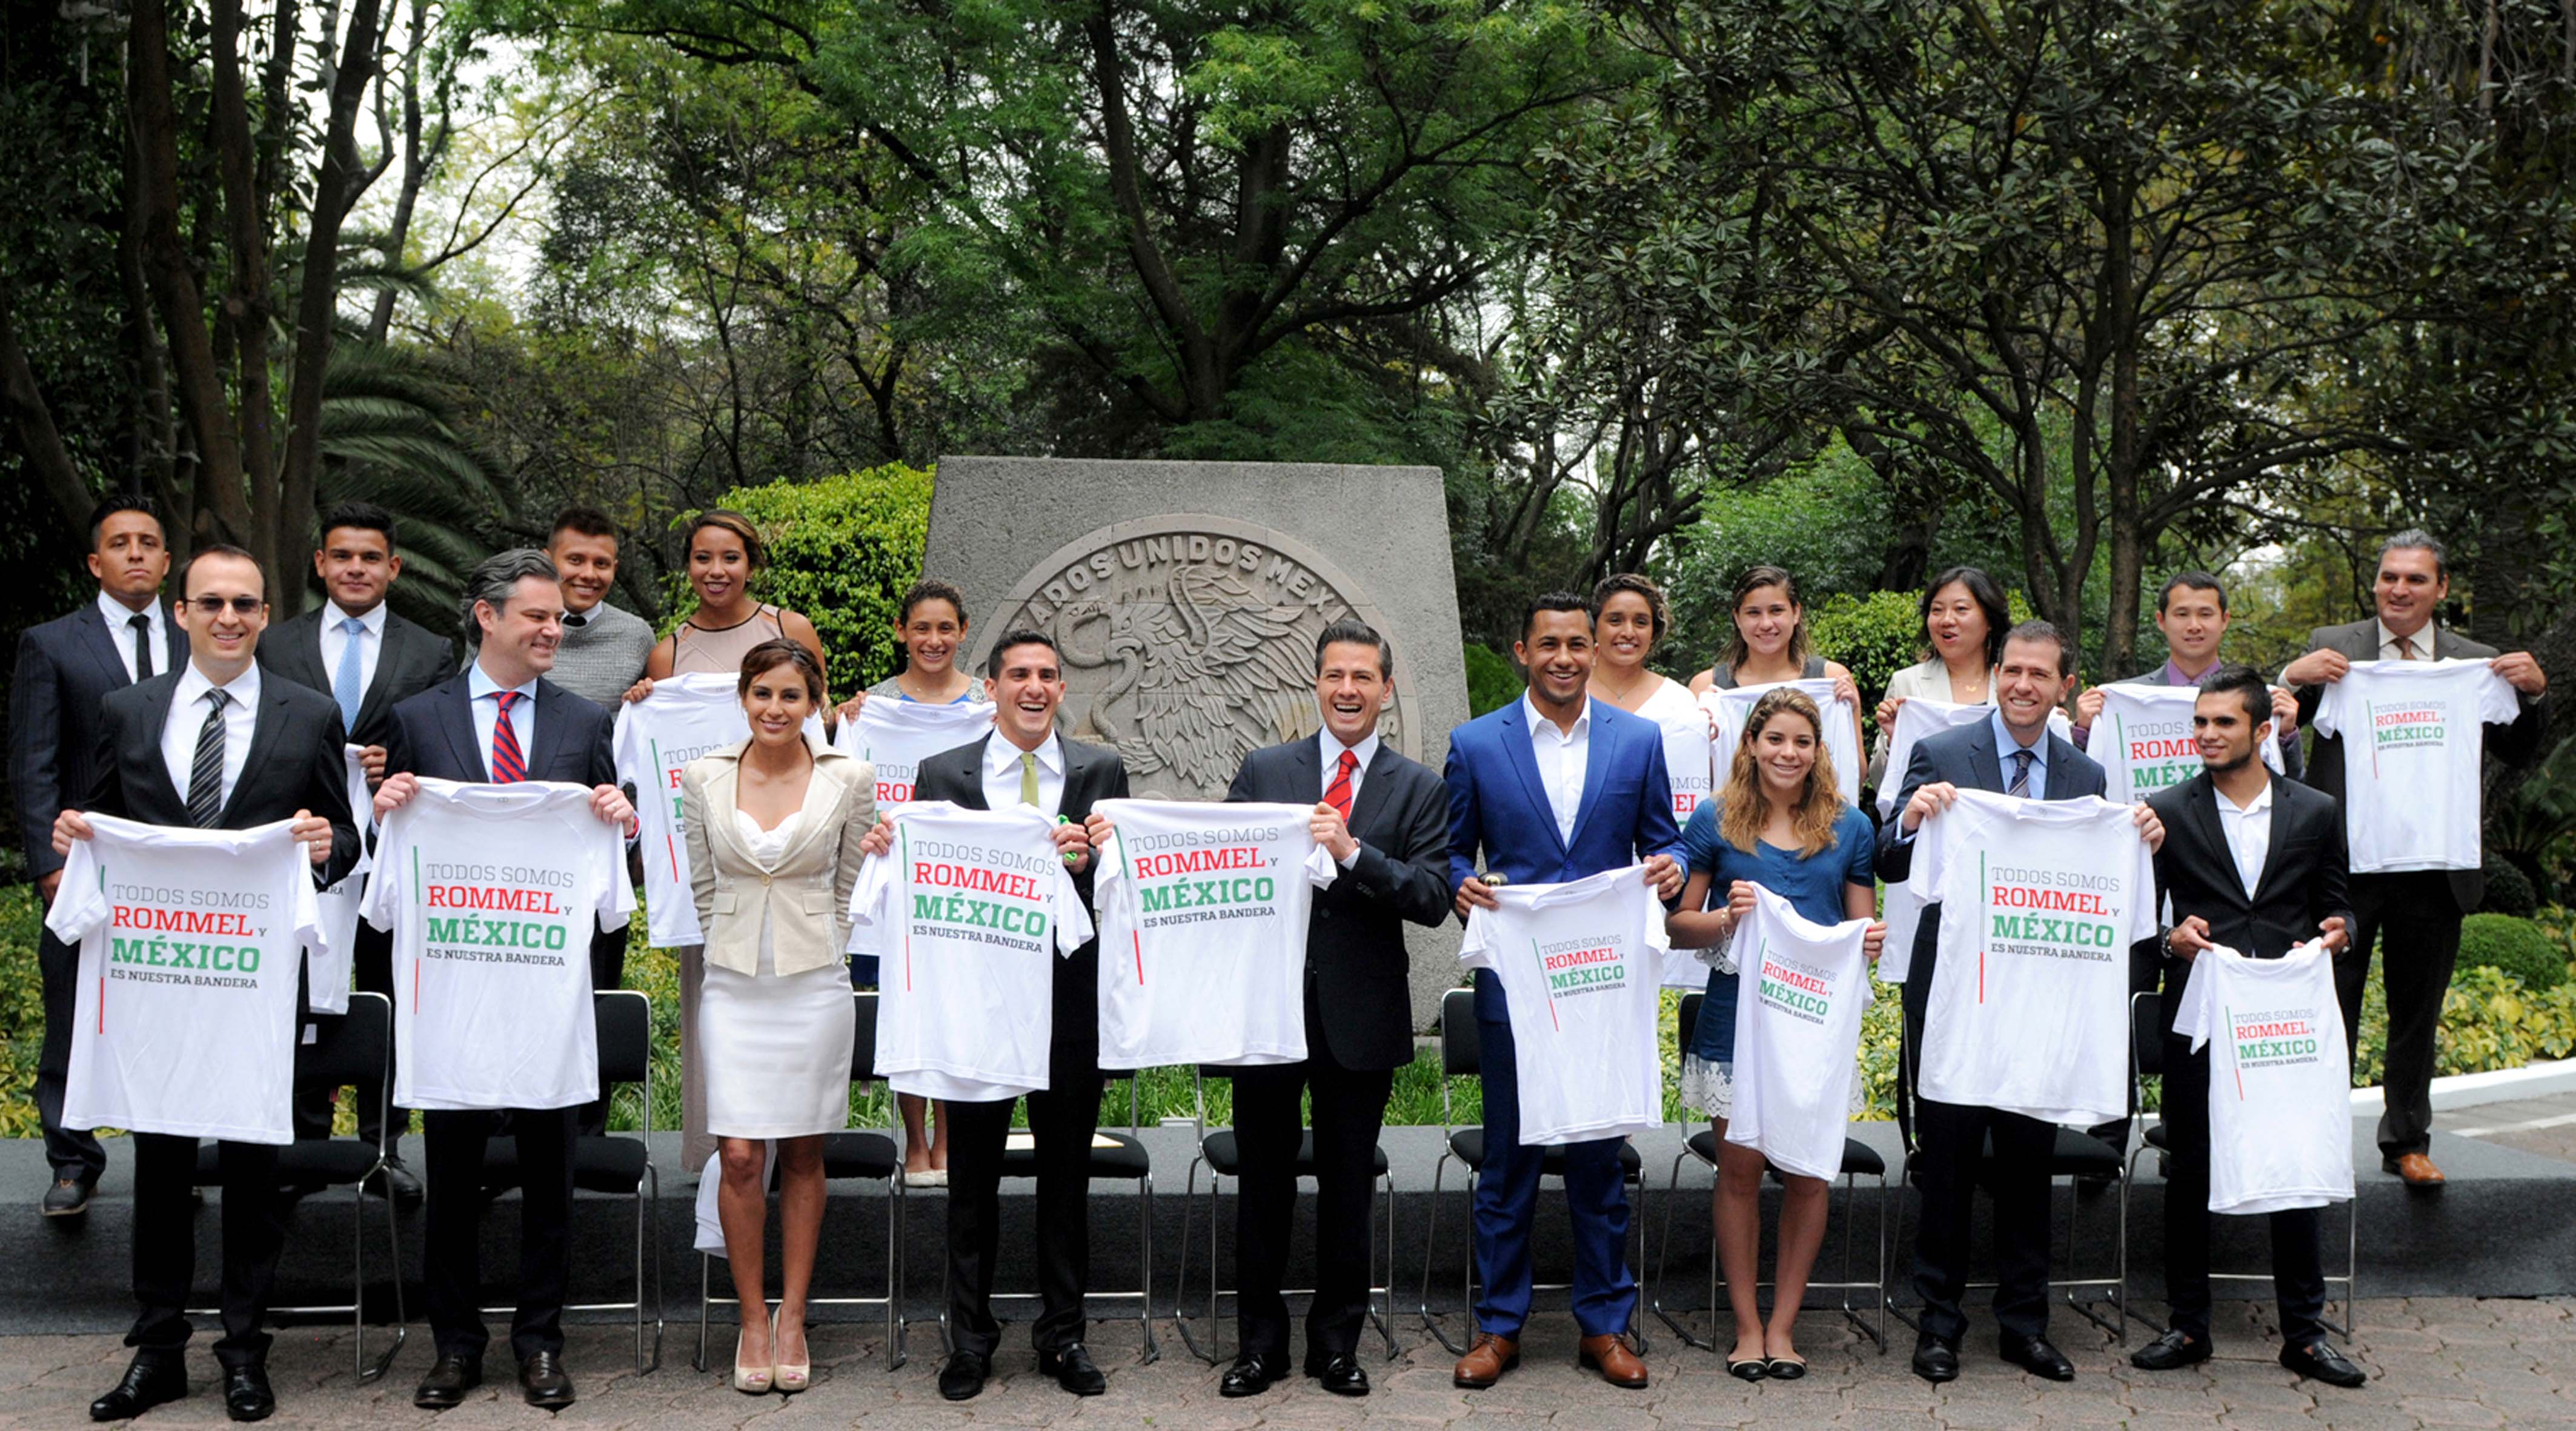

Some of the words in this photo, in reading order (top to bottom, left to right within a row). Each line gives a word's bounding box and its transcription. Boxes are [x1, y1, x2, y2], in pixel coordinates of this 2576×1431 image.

[1118, 536, 1263, 573] UNIDOS
[2127, 721, 2184, 737] TODOS
[2375, 711, 2439, 726] ROMMEL
[2377, 726, 2444, 743] MÉXICO
[876, 763, 918, 780] TODO
[1670, 777, 1710, 790] MOS
[2133, 760, 2204, 788] MÉX
[1130, 831, 1198, 852] TODOS
[1204, 828, 1279, 845] SOMOS
[914, 840, 983, 862] TODOS
[988, 849, 1056, 876] SOMOS
[1135, 847, 1266, 880] ROMMEL
[1270, 857, 1278, 866] Y
[427, 863, 496, 882] TODOS
[501, 866, 574, 889] SOMOS
[914, 862, 1041, 901] ROMMEL
[1046, 894, 1054, 903] Y
[1992, 866, 2051, 885] TODOS
[2056, 872, 2120, 892] SOMOS
[112, 884, 184, 905] TODOS
[190, 891, 270, 909] SOMOS
[428, 885, 560, 914] ROMMEL
[564, 906, 573, 916] Y
[1140, 877, 1274, 913] MÉXICO
[1992, 886, 2108, 915] ROMMEL
[112, 905, 253, 936] ROMMEL
[258, 928, 267, 937] Y
[913, 892, 1046, 937] MÉXICO
[1144, 918, 1157, 928] ES
[1160, 911, 1217, 926] NUESTRA
[1219, 907, 1276, 919] BANDERA
[427, 913, 566, 951] MÉXICO
[913, 925, 928, 935] ES
[929, 927, 983, 941] NUESTRA
[985, 934, 1042, 953] BANDERA
[1992, 912, 2114, 948] MÉXICO
[111, 935, 260, 972] MÉXICO
[427, 948, 442, 959] ES
[445, 949, 502, 963] NUESTRA
[505, 953, 565, 966] BANDERA
[1541, 940, 1579, 954] TODOS
[1581, 934, 1622, 948] SOMOS
[1991, 943, 2005, 952] ES
[2007, 945, 2058, 957] NUESTRA
[2061, 949, 2113, 962] BANDERA
[1545, 947, 1618, 970] ROMMEL
[1767, 949, 1798, 970] TODOS
[1800, 964, 1837, 982] SOMOS
[110, 969, 125, 980] ES
[128, 971, 191, 984] NUESTRA
[194, 975, 258, 989] BANDERA
[1549, 965, 1624, 989] MÉXICO
[1763, 961, 1827, 995] ROMMEL
[1759, 979, 1828, 1016] MÉXICO
[2234, 1012, 2271, 1024] TODOS
[2274, 1009, 2314, 1020] SOMOS
[2236, 1021, 2309, 1040] ROMMEL
[2239, 1039, 2316, 1059] MÉXICO
